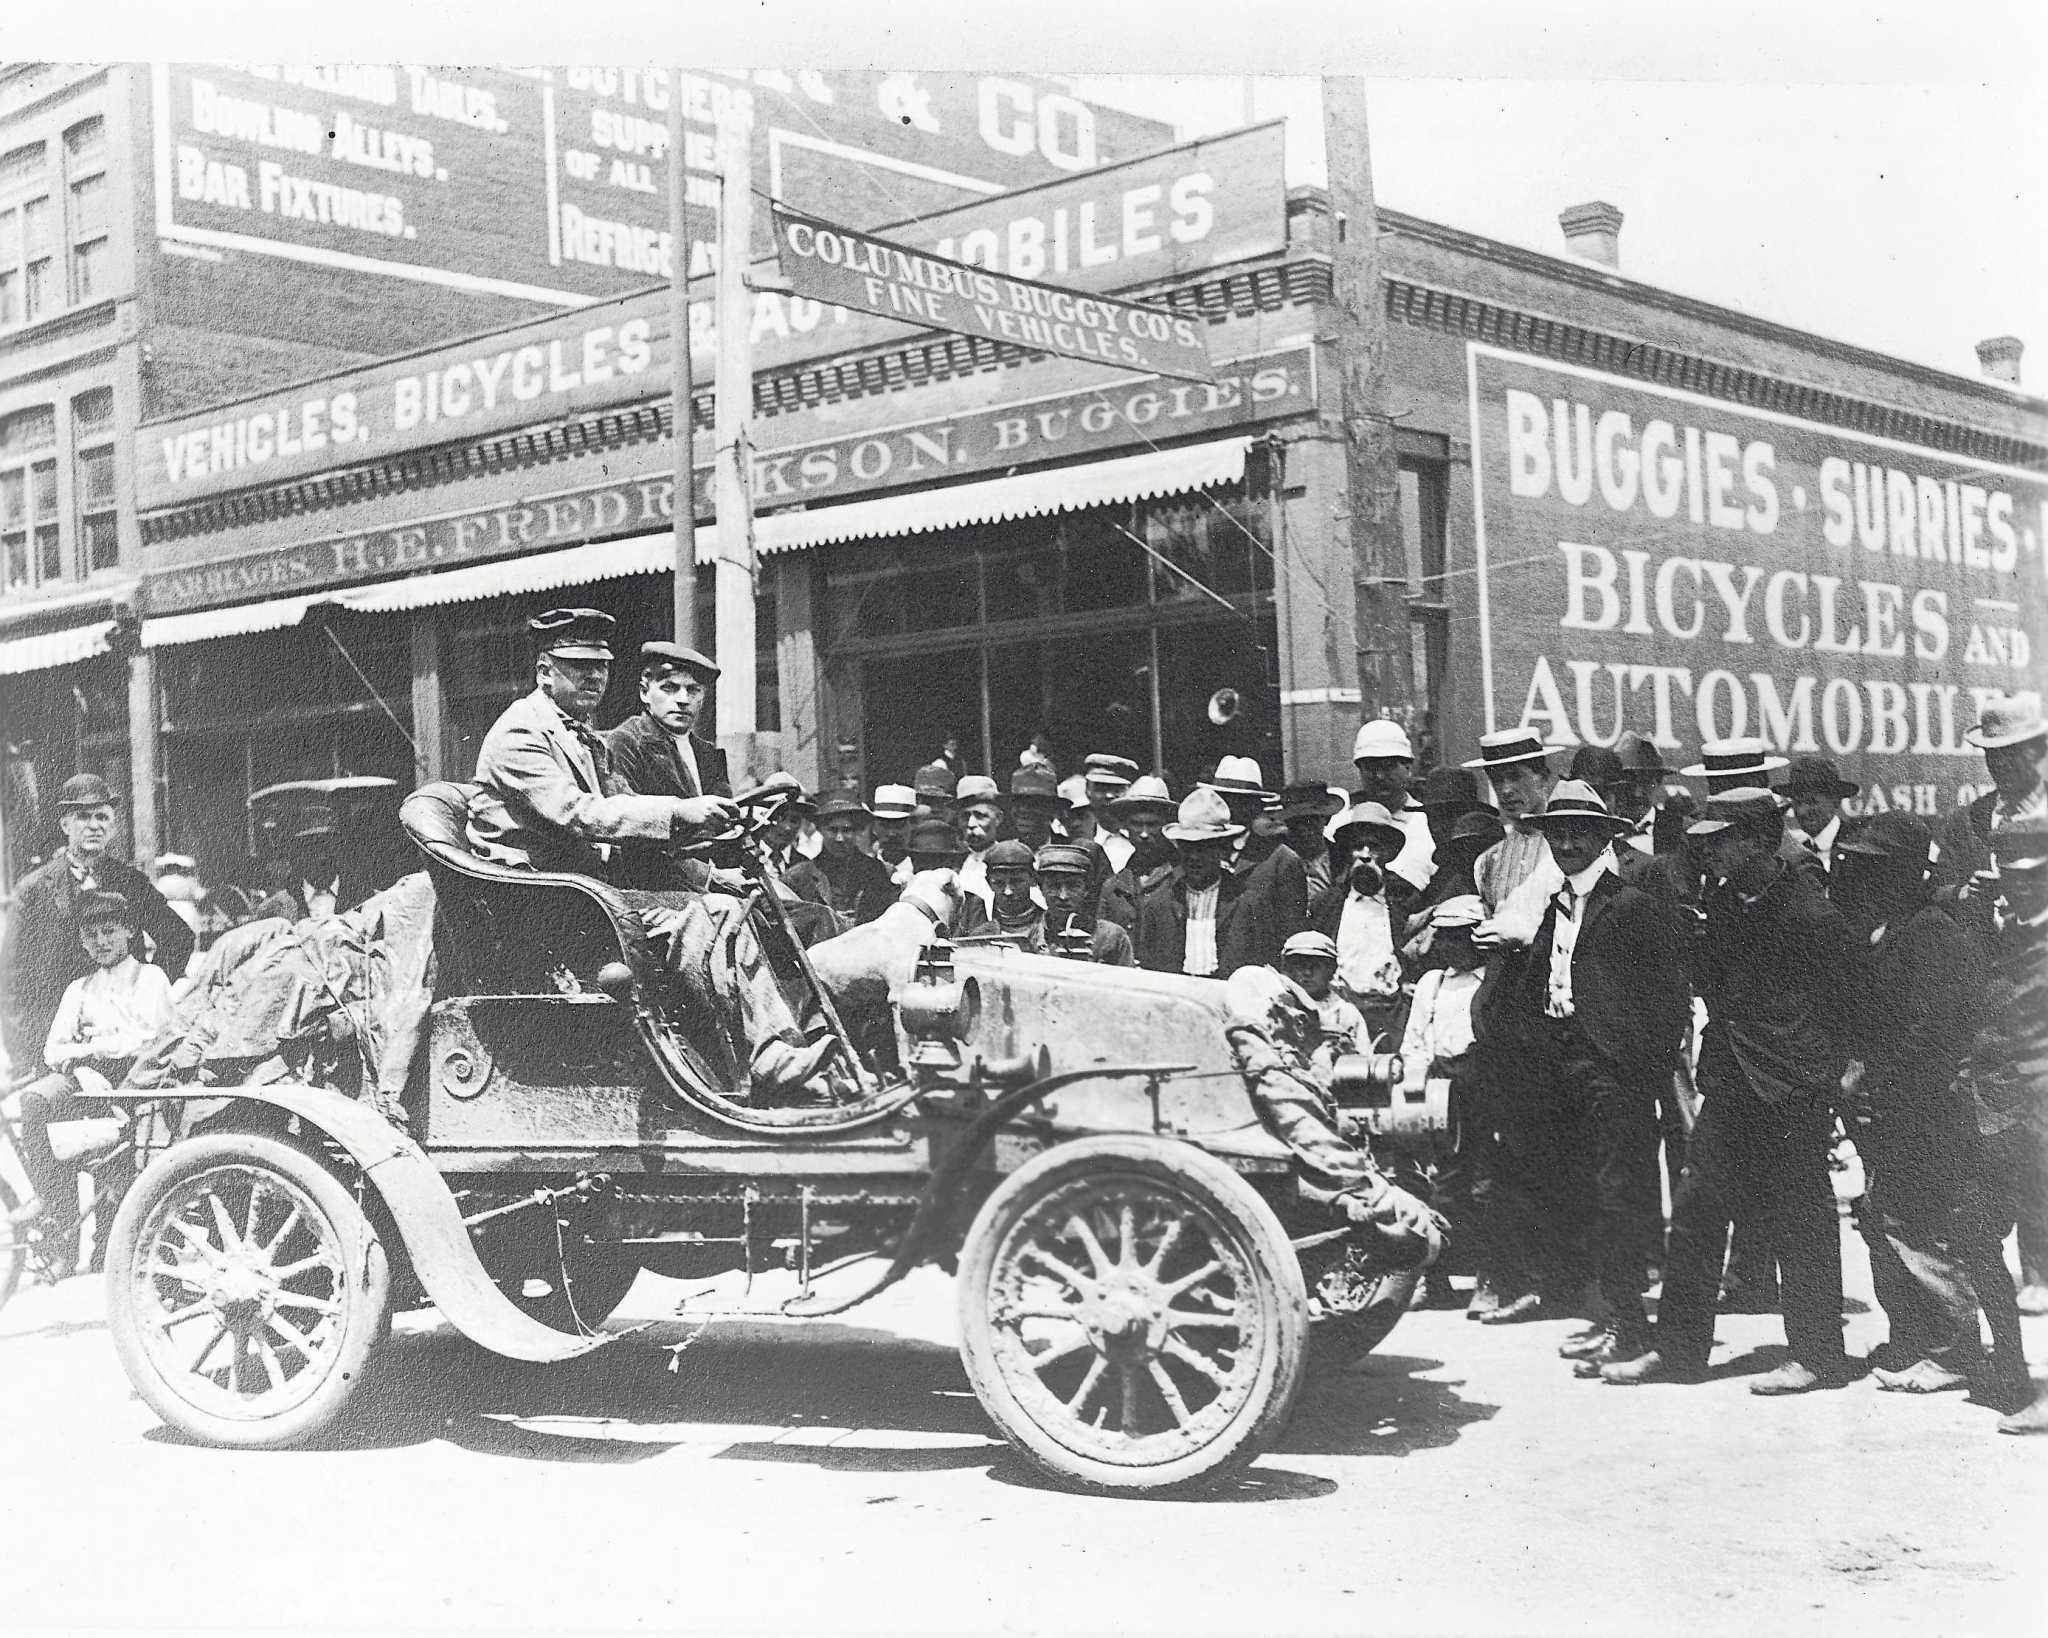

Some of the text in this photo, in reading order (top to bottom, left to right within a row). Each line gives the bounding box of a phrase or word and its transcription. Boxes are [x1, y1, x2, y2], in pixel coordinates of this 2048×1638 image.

[177, 144, 418, 240] BAR FIXTURES.
[331, 110, 449, 182] ALLEYS.
[609, 159, 658, 194] ALL
[786, 223, 1000, 305] COLUMBUS
[1007, 281, 1122, 333] BUGGY
[864, 276, 1150, 366] FINE VEHICLES.
[162, 390, 370, 484] VEHICLES,
[393, 317, 652, 430] BICYCLES
[992, 366, 1300, 452] BUGGIES.
[1557, 541, 2030, 669] BICYCLES AND
[1518, 655, 2006, 757] AUTOMOBIL
[1840, 783, 1937, 817] CASH
